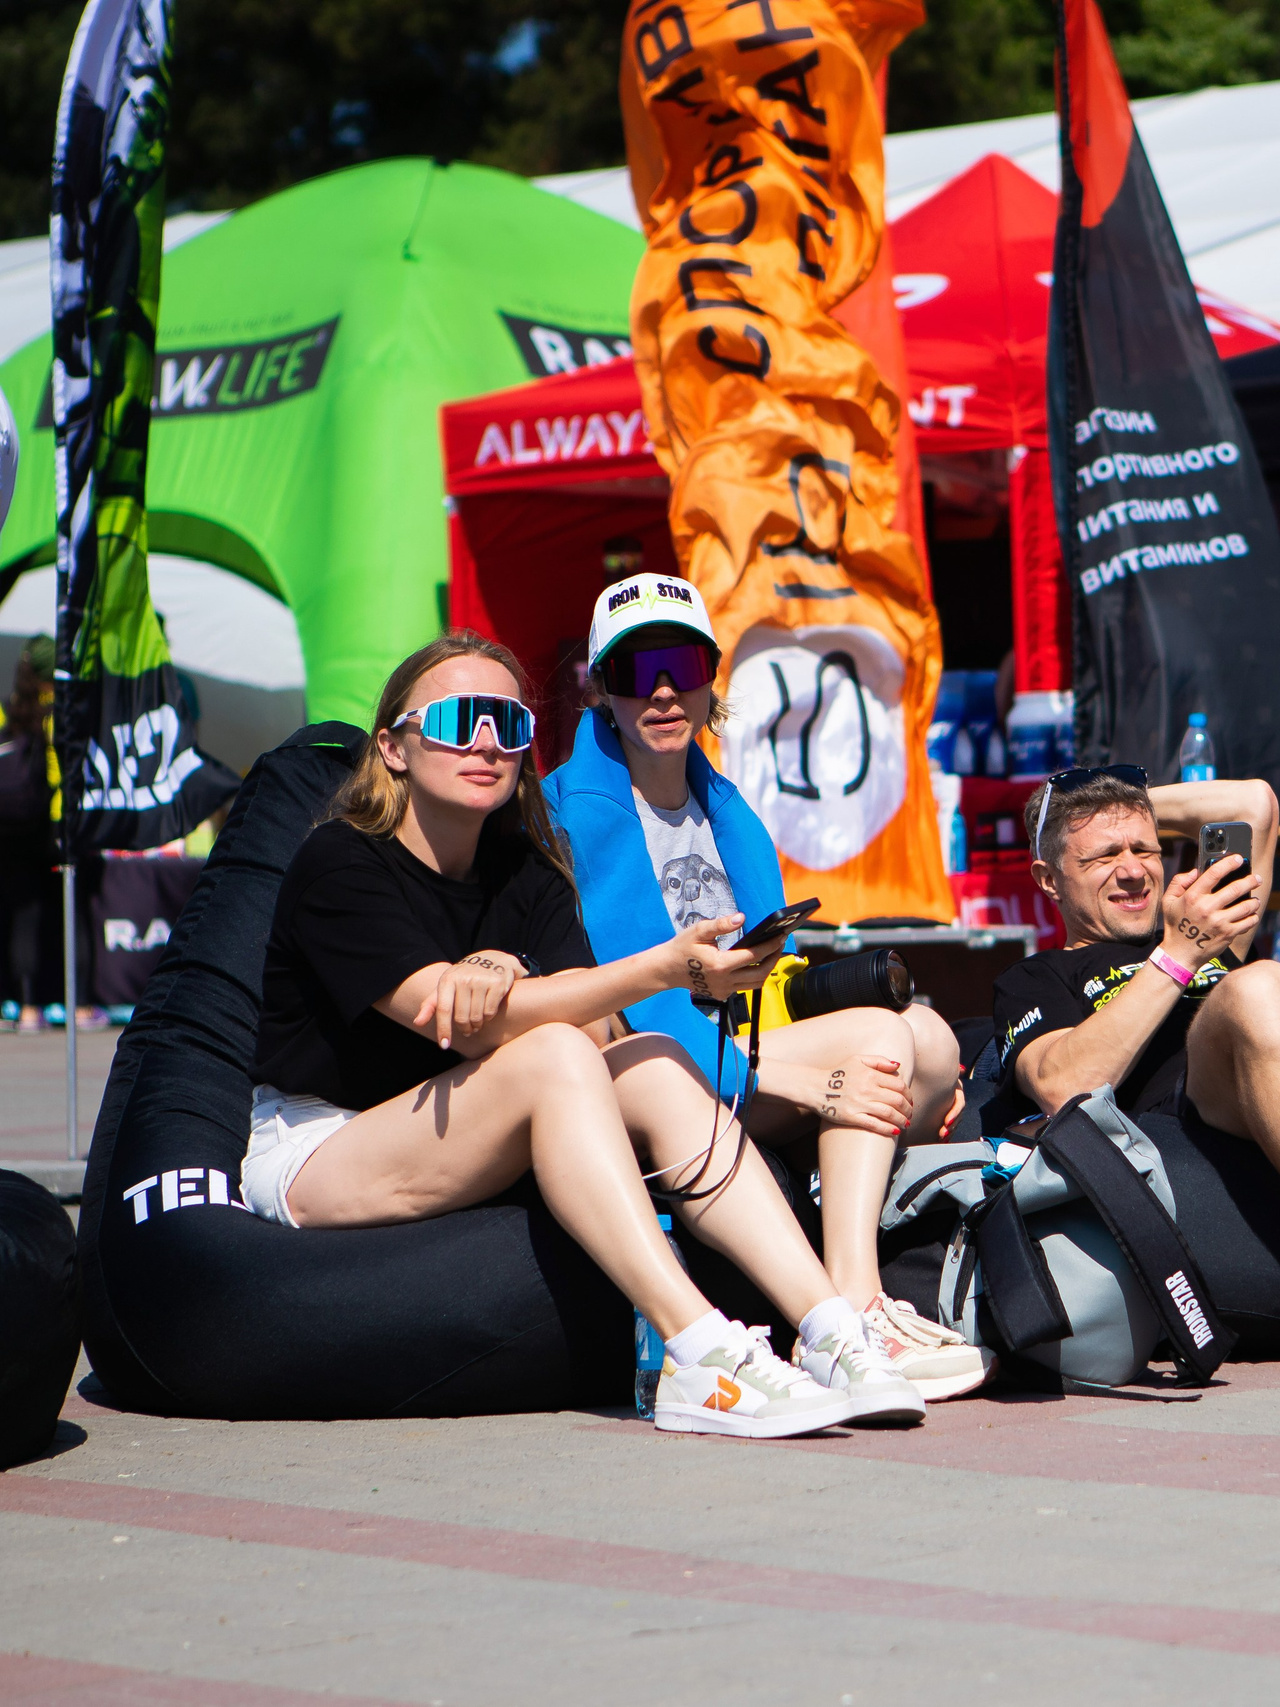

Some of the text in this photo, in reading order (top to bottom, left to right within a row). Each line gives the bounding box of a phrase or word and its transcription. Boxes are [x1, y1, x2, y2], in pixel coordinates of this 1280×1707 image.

[1192, 491, 1220, 517] и
[1080, 533, 1249, 596] витаминов
[608, 582, 693, 612] IRON STAR
[1177, 917, 1212, 949] 263
[820, 1069, 846, 1117] 5169
[1164, 1269, 1214, 1350] IRONSTAR
